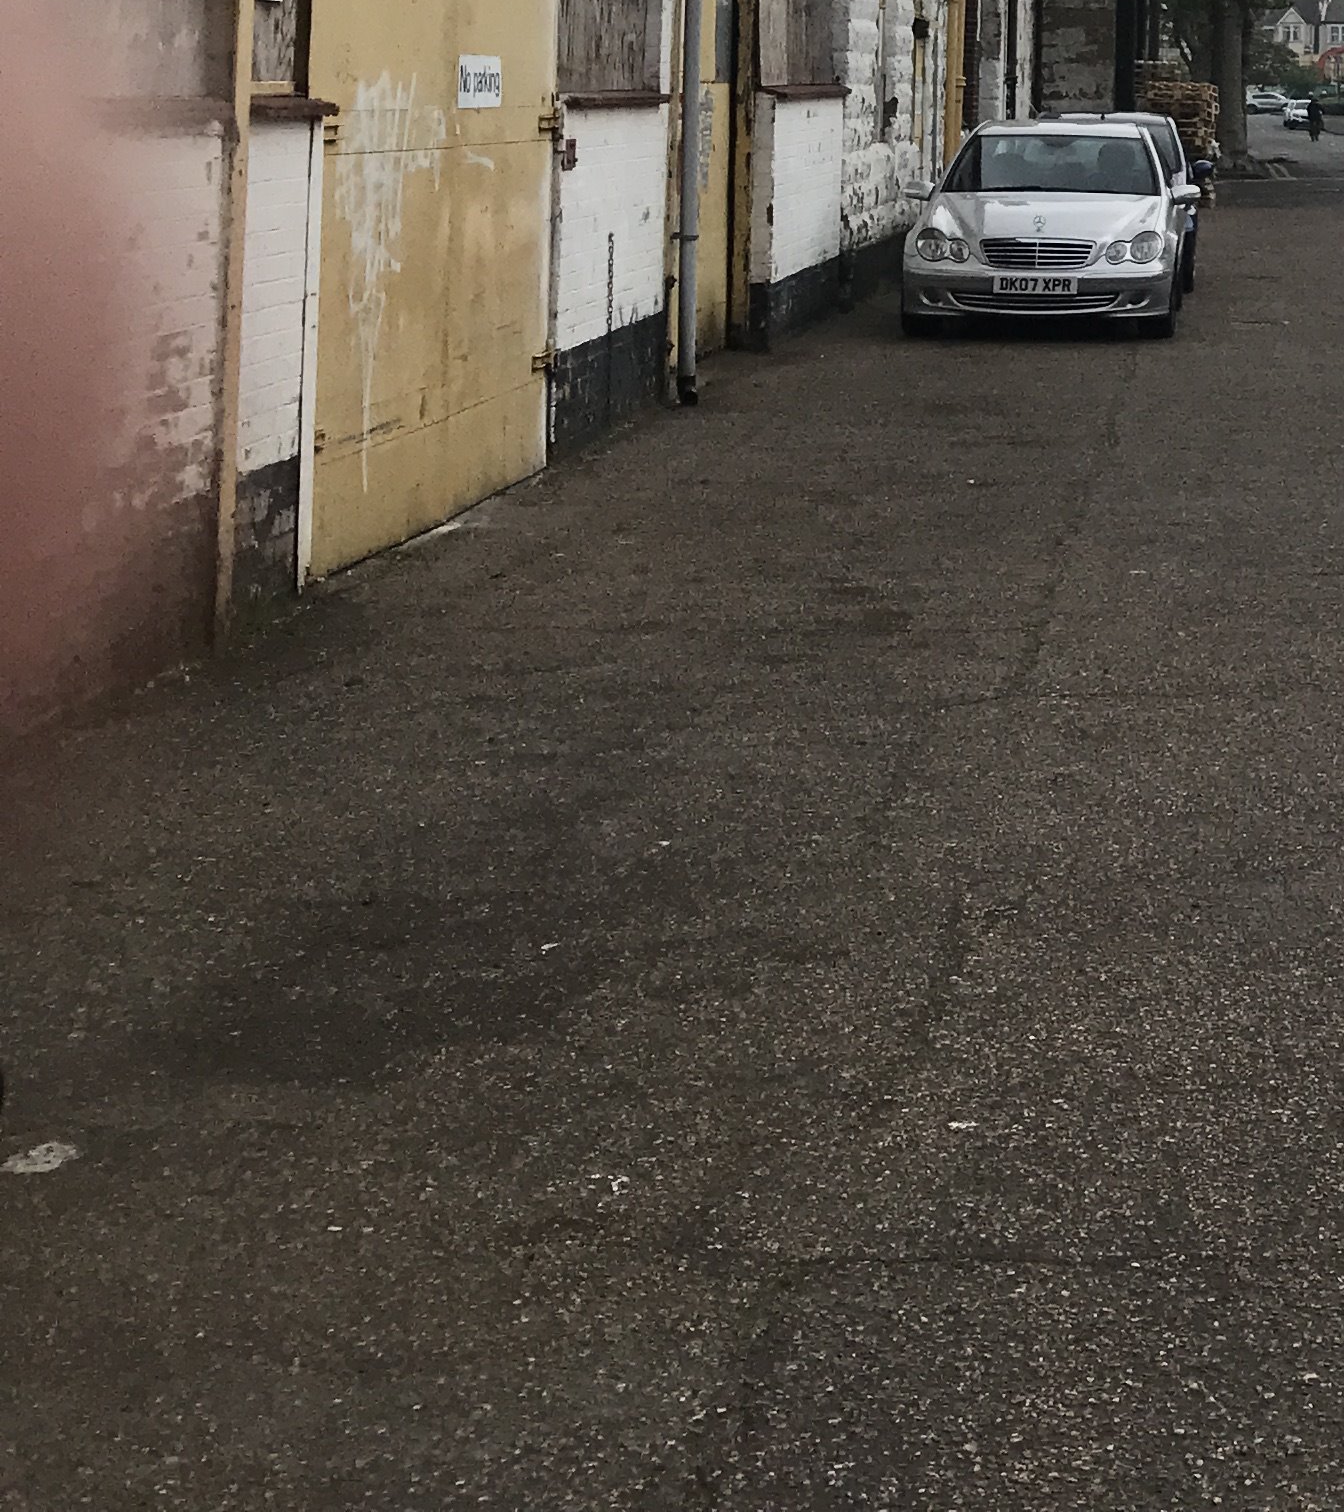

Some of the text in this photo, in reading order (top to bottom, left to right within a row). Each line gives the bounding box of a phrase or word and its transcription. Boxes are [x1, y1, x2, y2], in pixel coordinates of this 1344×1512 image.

[459, 65, 500, 98] No parking
[1000, 277, 1071, 292] DK07 XPR
